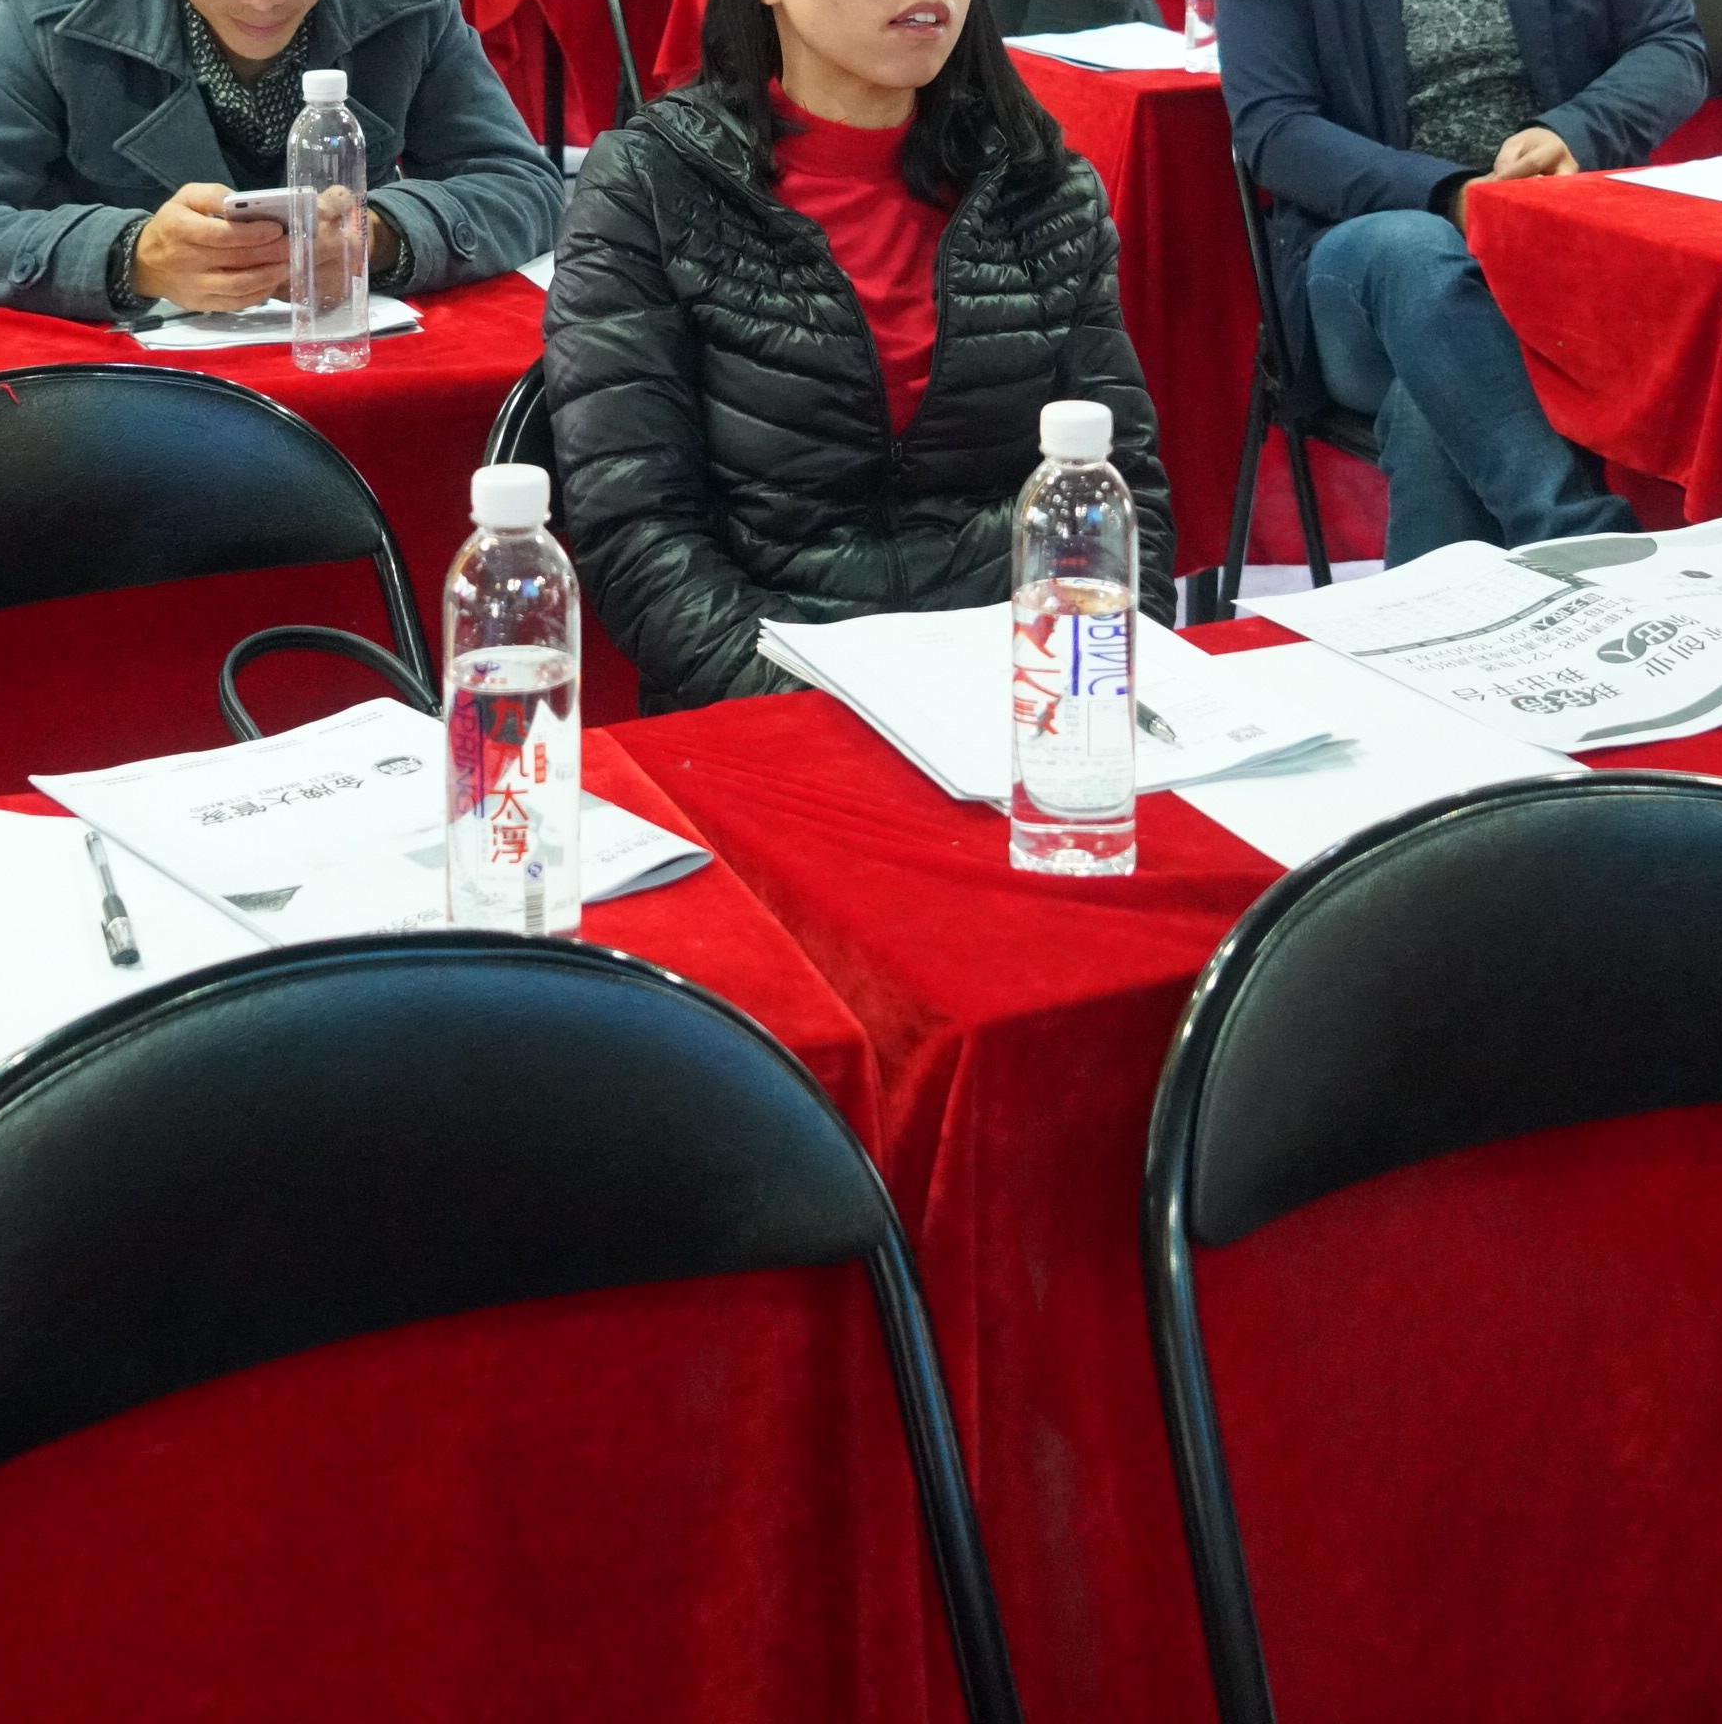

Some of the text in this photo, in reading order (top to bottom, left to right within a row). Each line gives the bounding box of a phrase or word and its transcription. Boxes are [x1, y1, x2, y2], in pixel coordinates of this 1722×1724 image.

[1451, 666, 1589, 702] 我出平台
[1513, 680, 1625, 715] 我扶持
[190, 774, 365, 827] 金牌大管家
